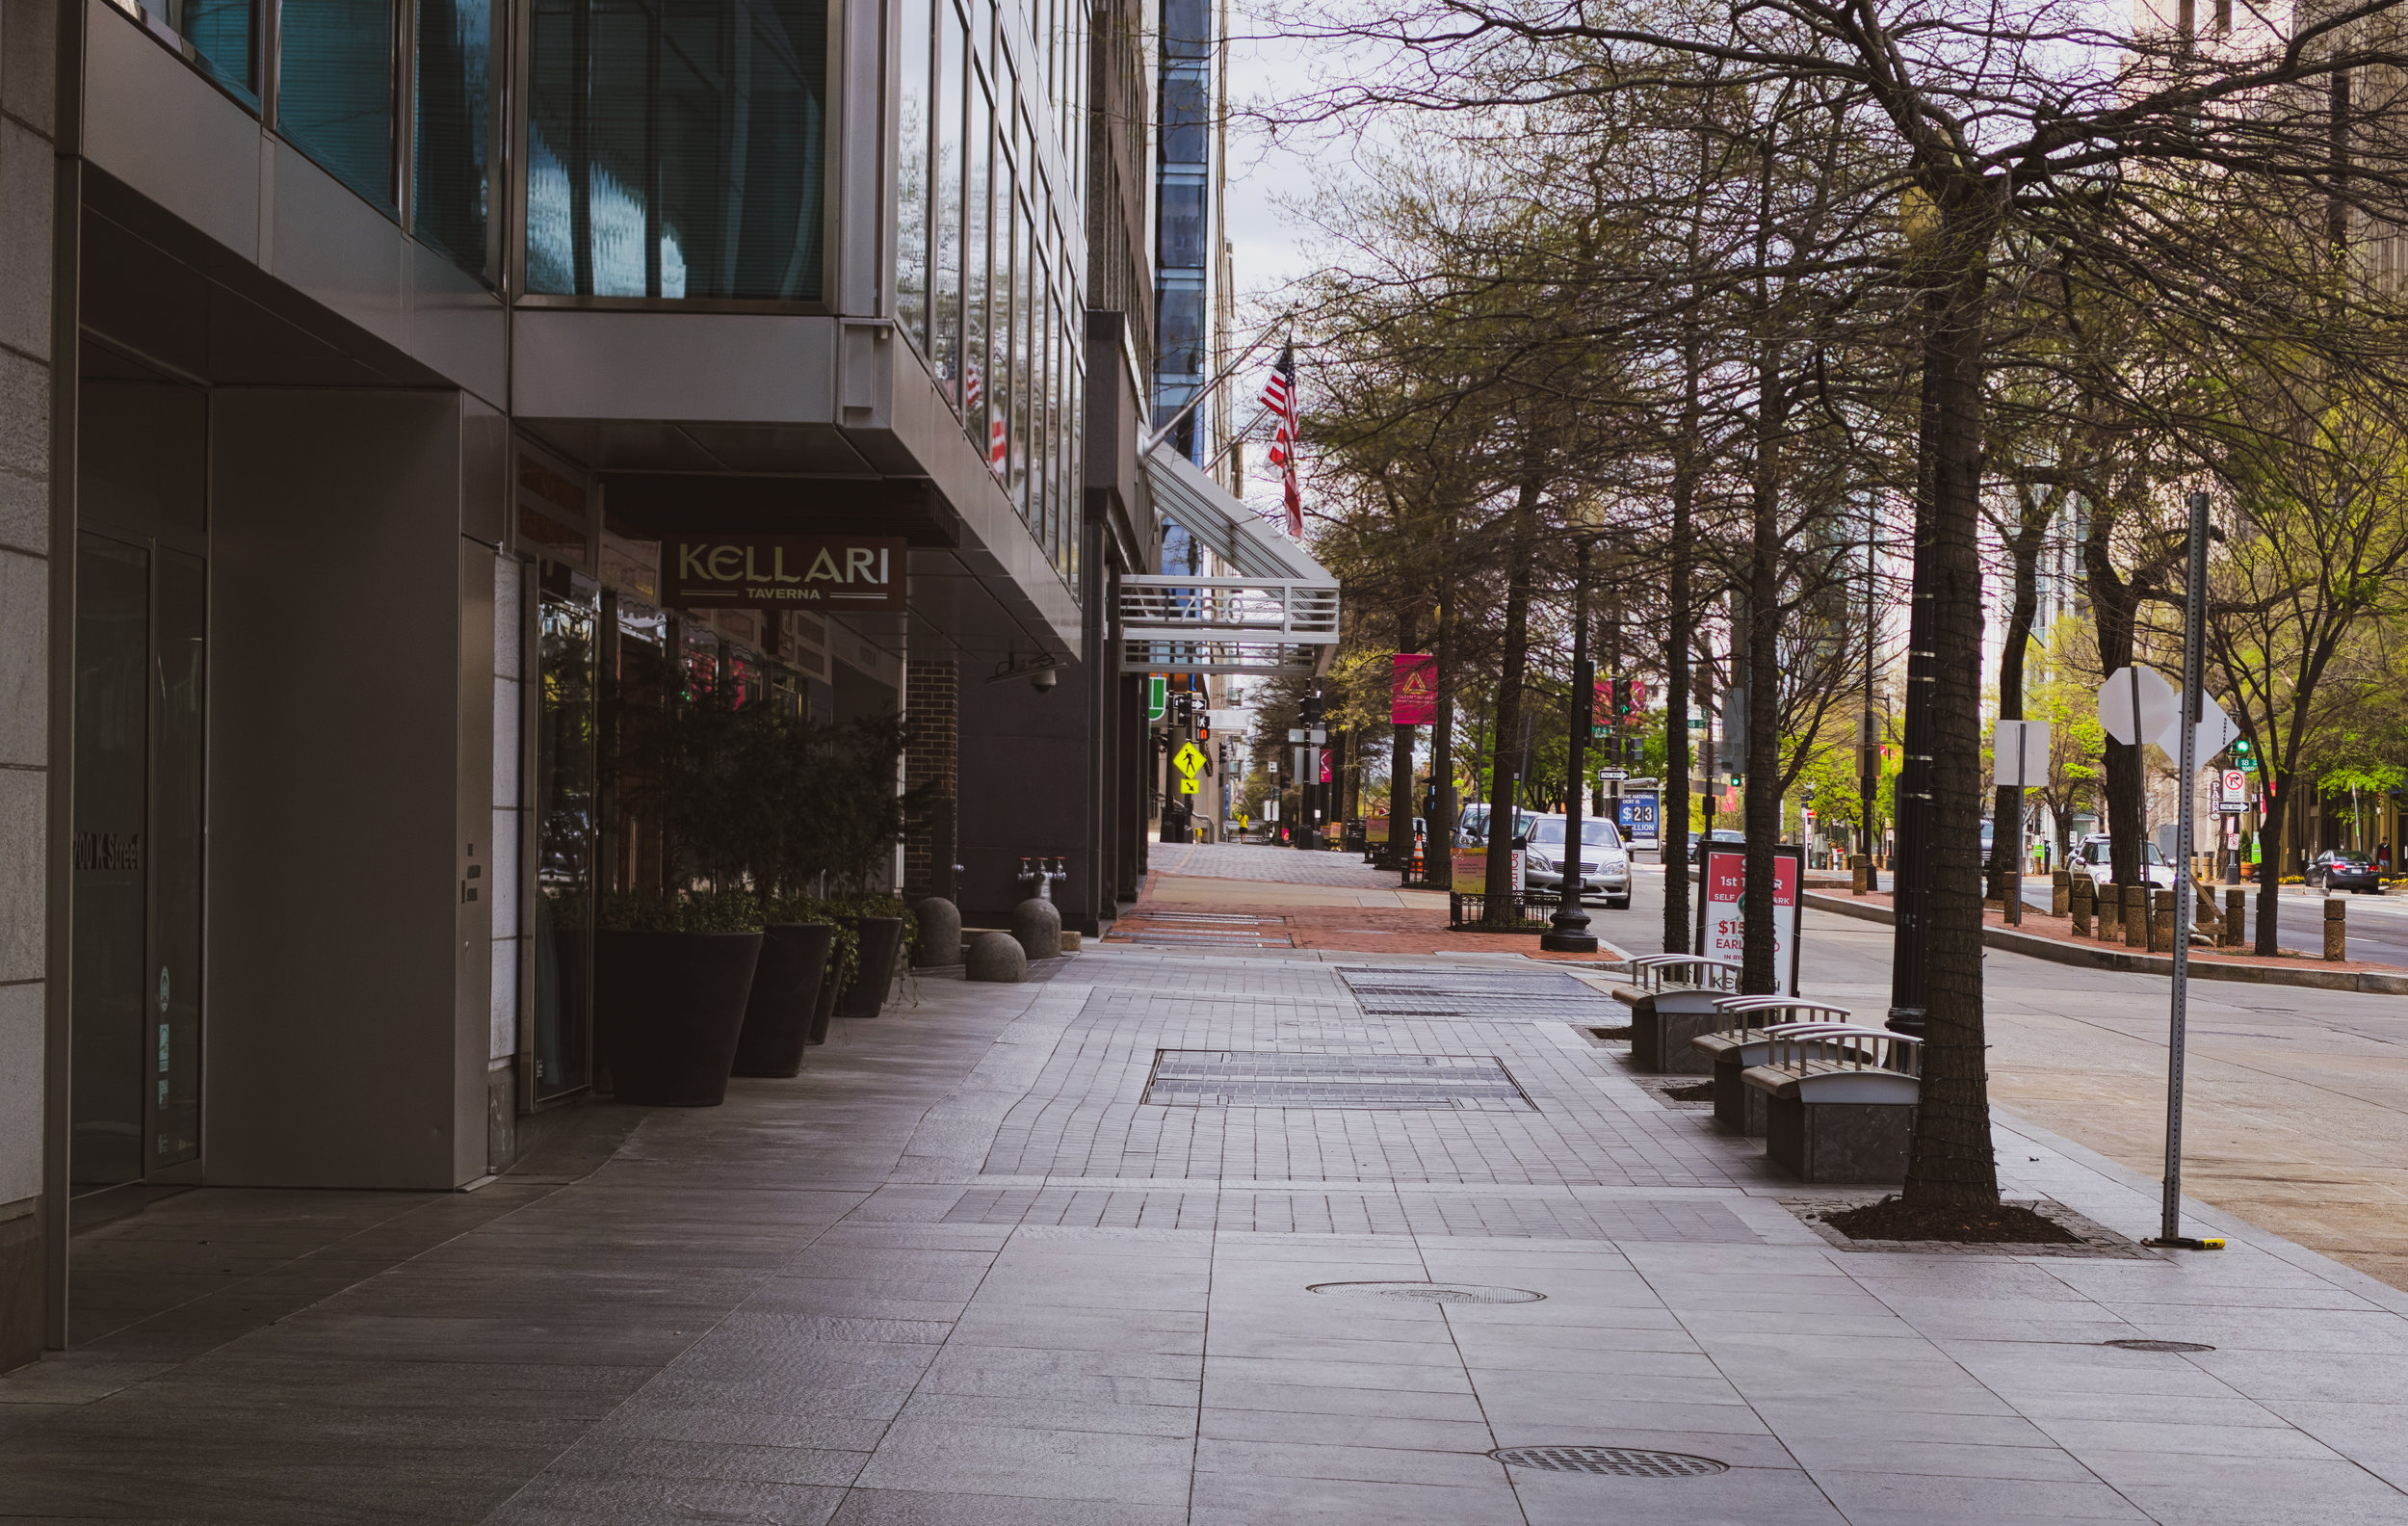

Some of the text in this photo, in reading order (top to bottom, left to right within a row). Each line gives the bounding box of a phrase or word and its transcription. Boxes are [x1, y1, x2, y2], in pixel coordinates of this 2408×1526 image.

[679, 543, 888, 584] KELLARI
[746, 588, 821, 599] TAVERNA
[1720, 876, 1738, 887] 1st
[1715, 938, 1744, 950] EARL
